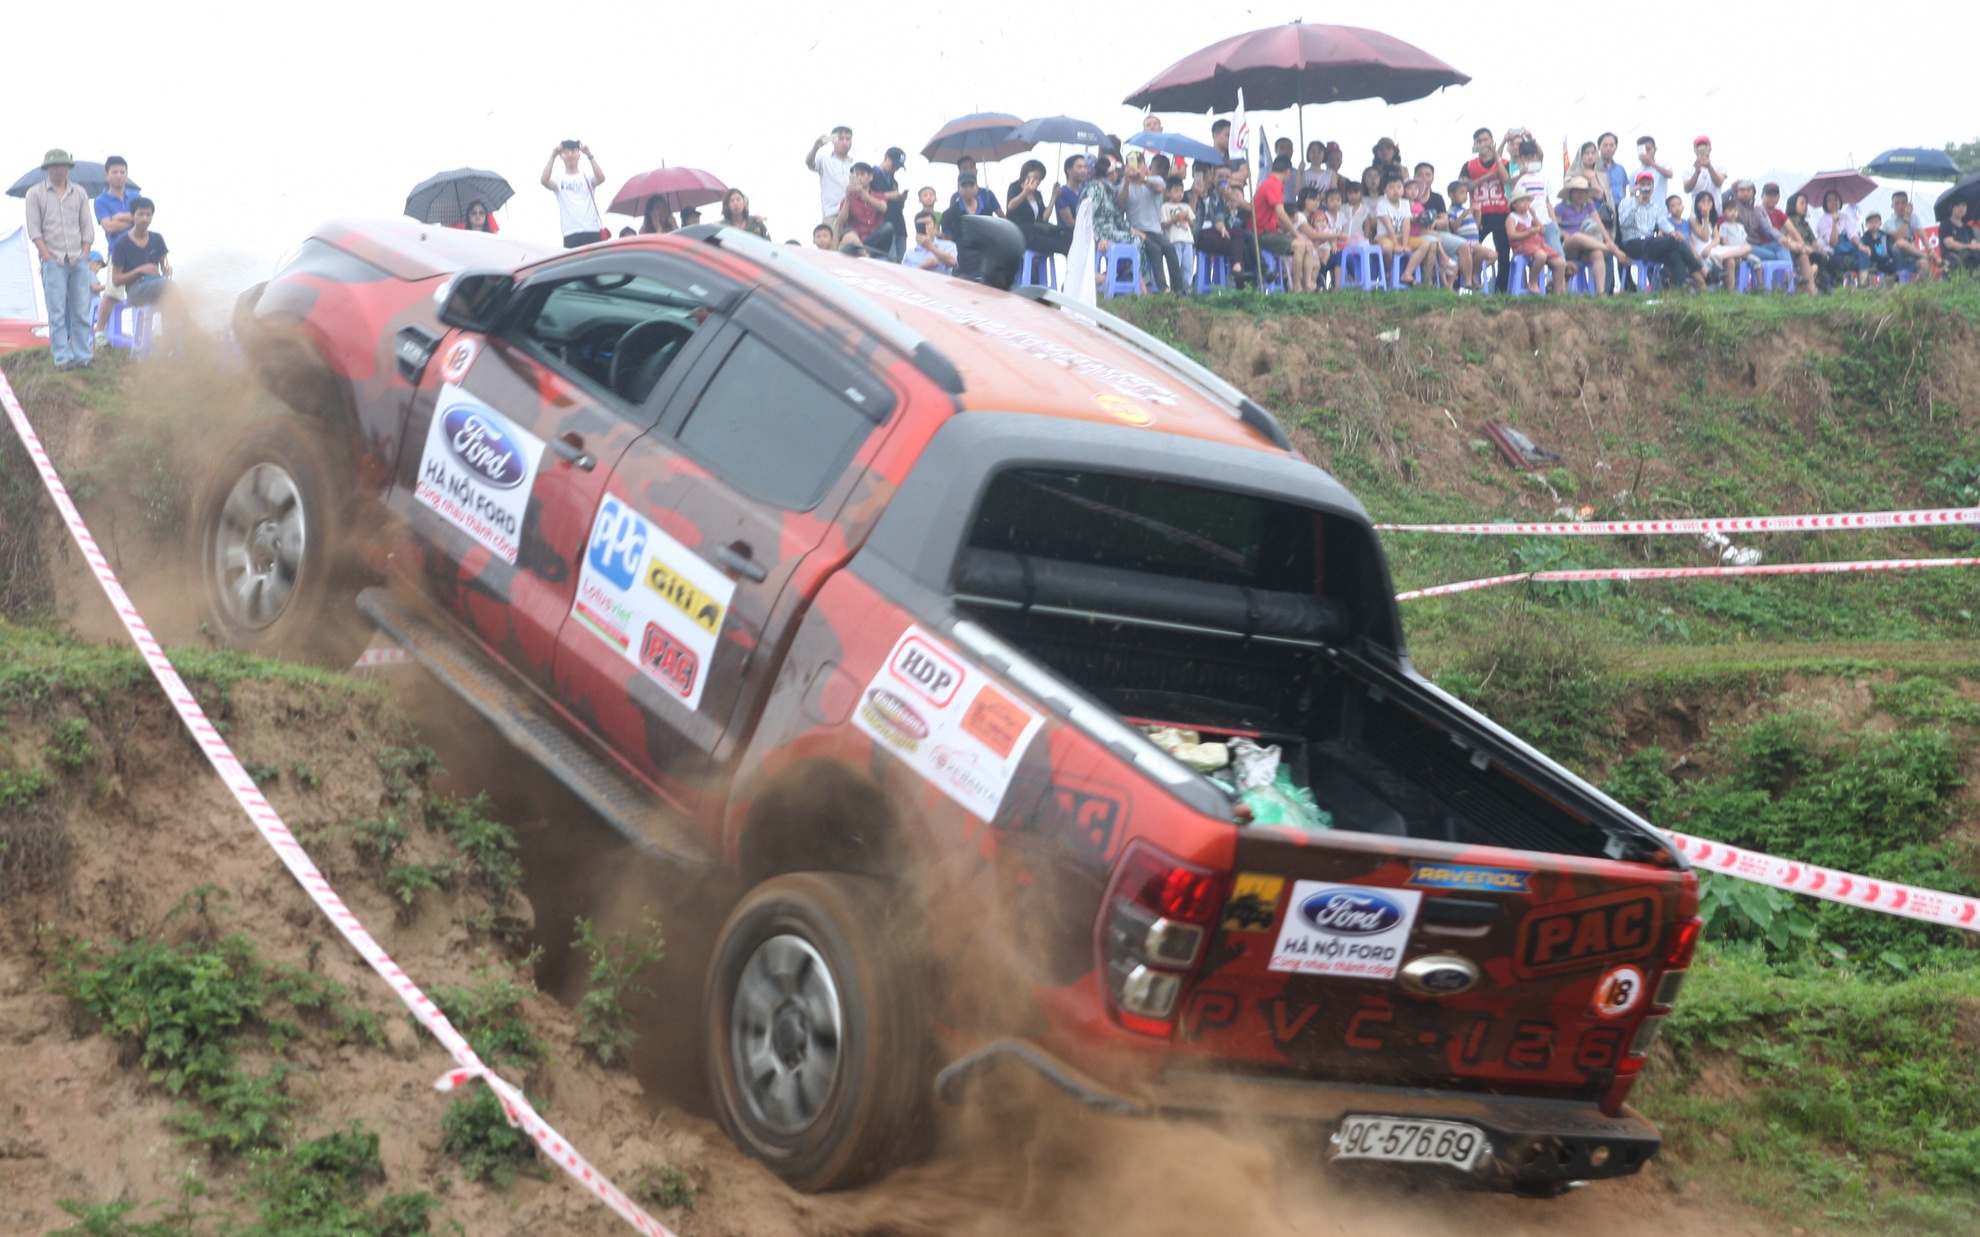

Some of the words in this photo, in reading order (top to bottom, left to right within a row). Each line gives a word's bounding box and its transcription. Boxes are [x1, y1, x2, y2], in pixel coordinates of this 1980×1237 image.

[453, 415, 513, 480] Ford
[426, 457, 445, 485] HÀ
[449, 474, 475, 507] NỘI
[476, 494, 516, 536] FORD
[592, 505, 646, 576] PPG
[651, 567, 695, 611] Giti
[648, 636, 692, 687] PAC
[900, 646, 953, 694] HDP
[1417, 867, 1522, 887] RAVENOL
[1316, 894, 1387, 930] Ford
[1532, 902, 1645, 963] PAC
[1284, 935, 1308, 954] HÀ
[1312, 937, 1343, 960] NỘI
[1349, 944, 1395, 961] FORD
[1427, 972, 1468, 989] Ford
[1605, 978, 1632, 1008] 18
